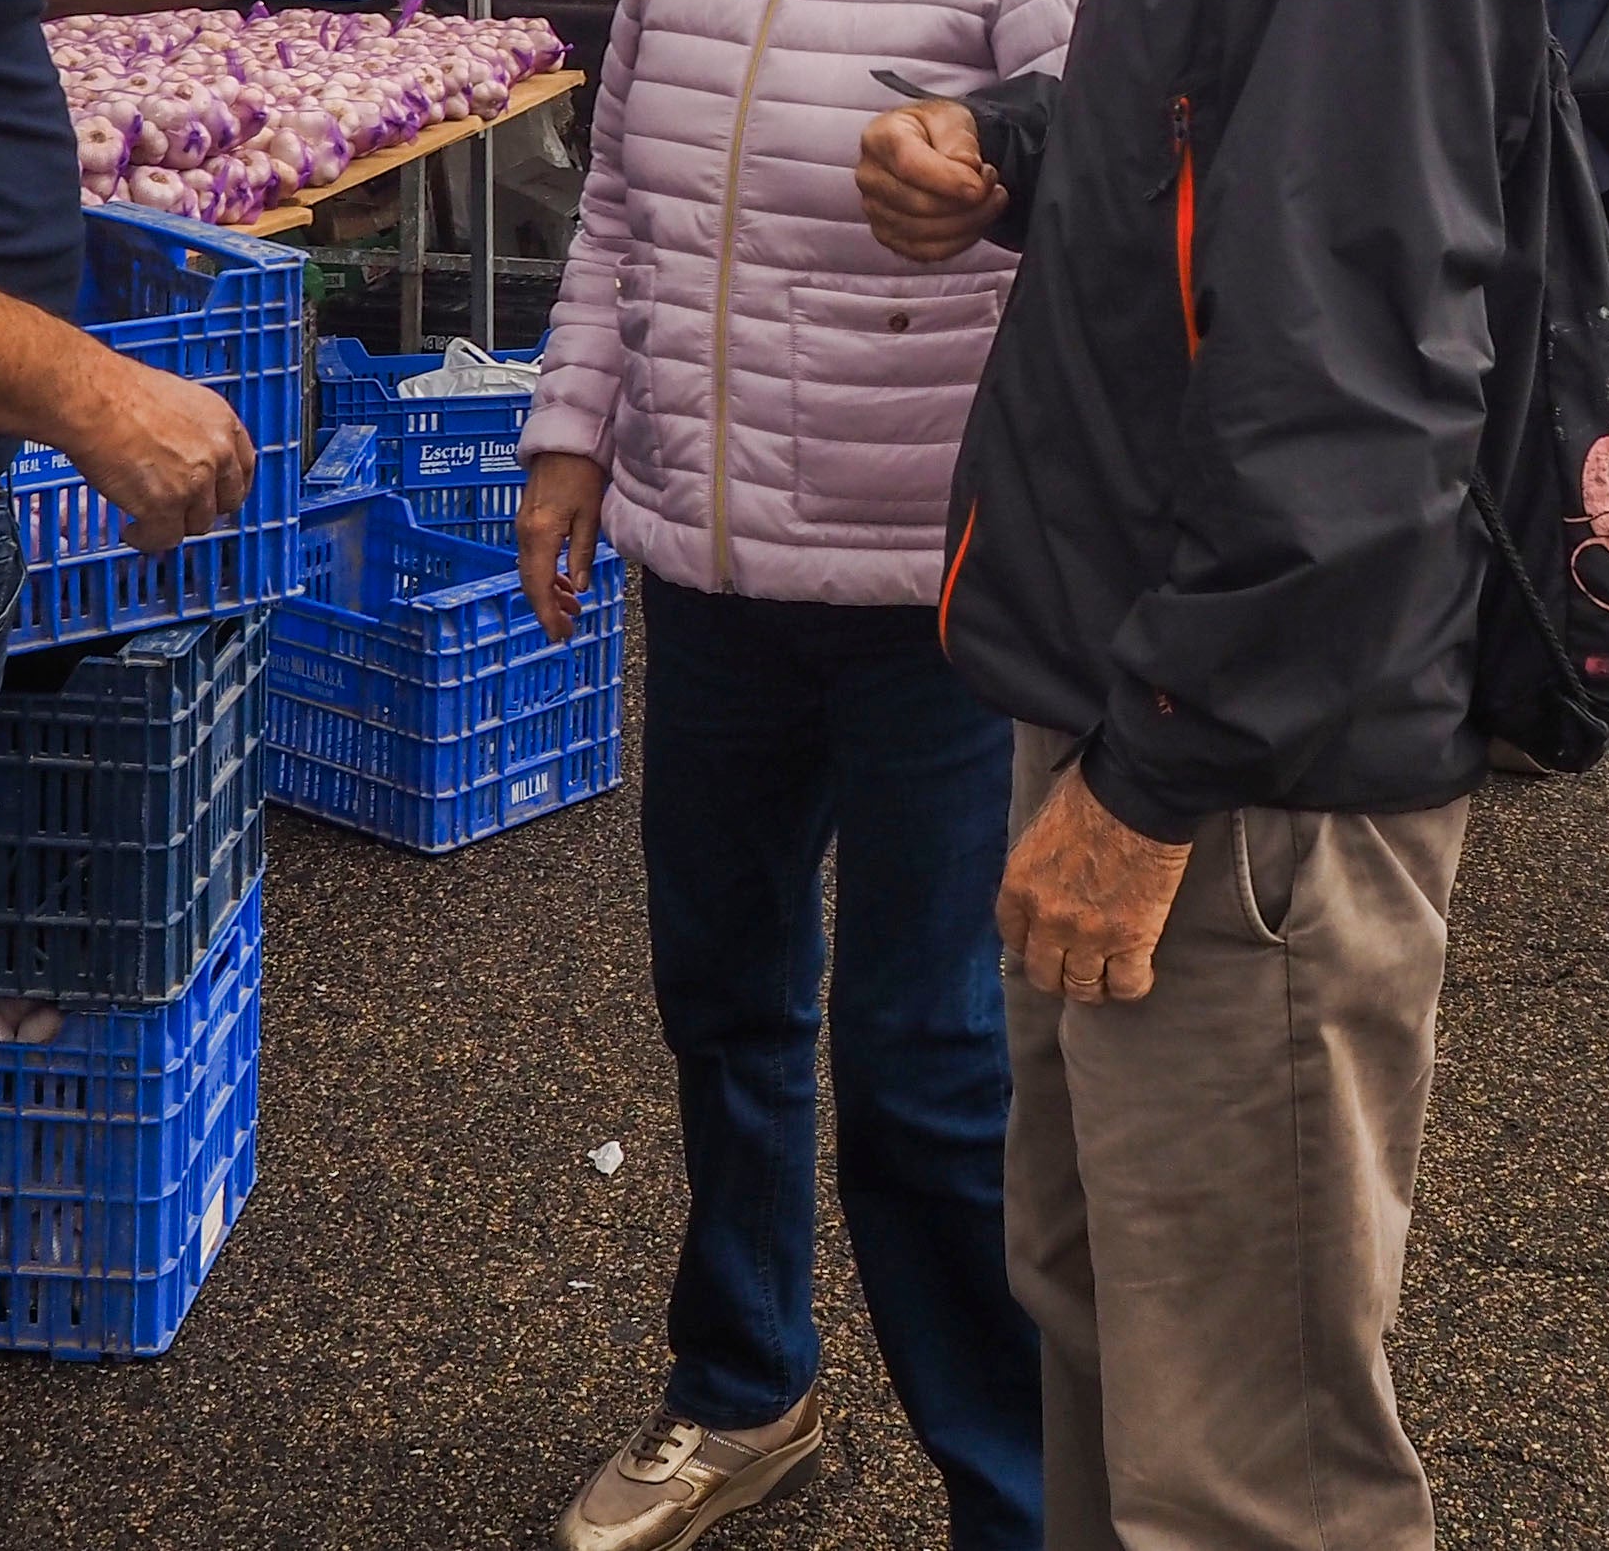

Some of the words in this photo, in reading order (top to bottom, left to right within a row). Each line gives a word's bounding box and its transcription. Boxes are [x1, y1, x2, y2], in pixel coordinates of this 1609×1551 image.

[19, 458, 42, 475] REAL
[51, 453, 74, 469] PUE
[420, 441, 476, 465] Escrig
[511, 771, 549, 805] MILLAN
